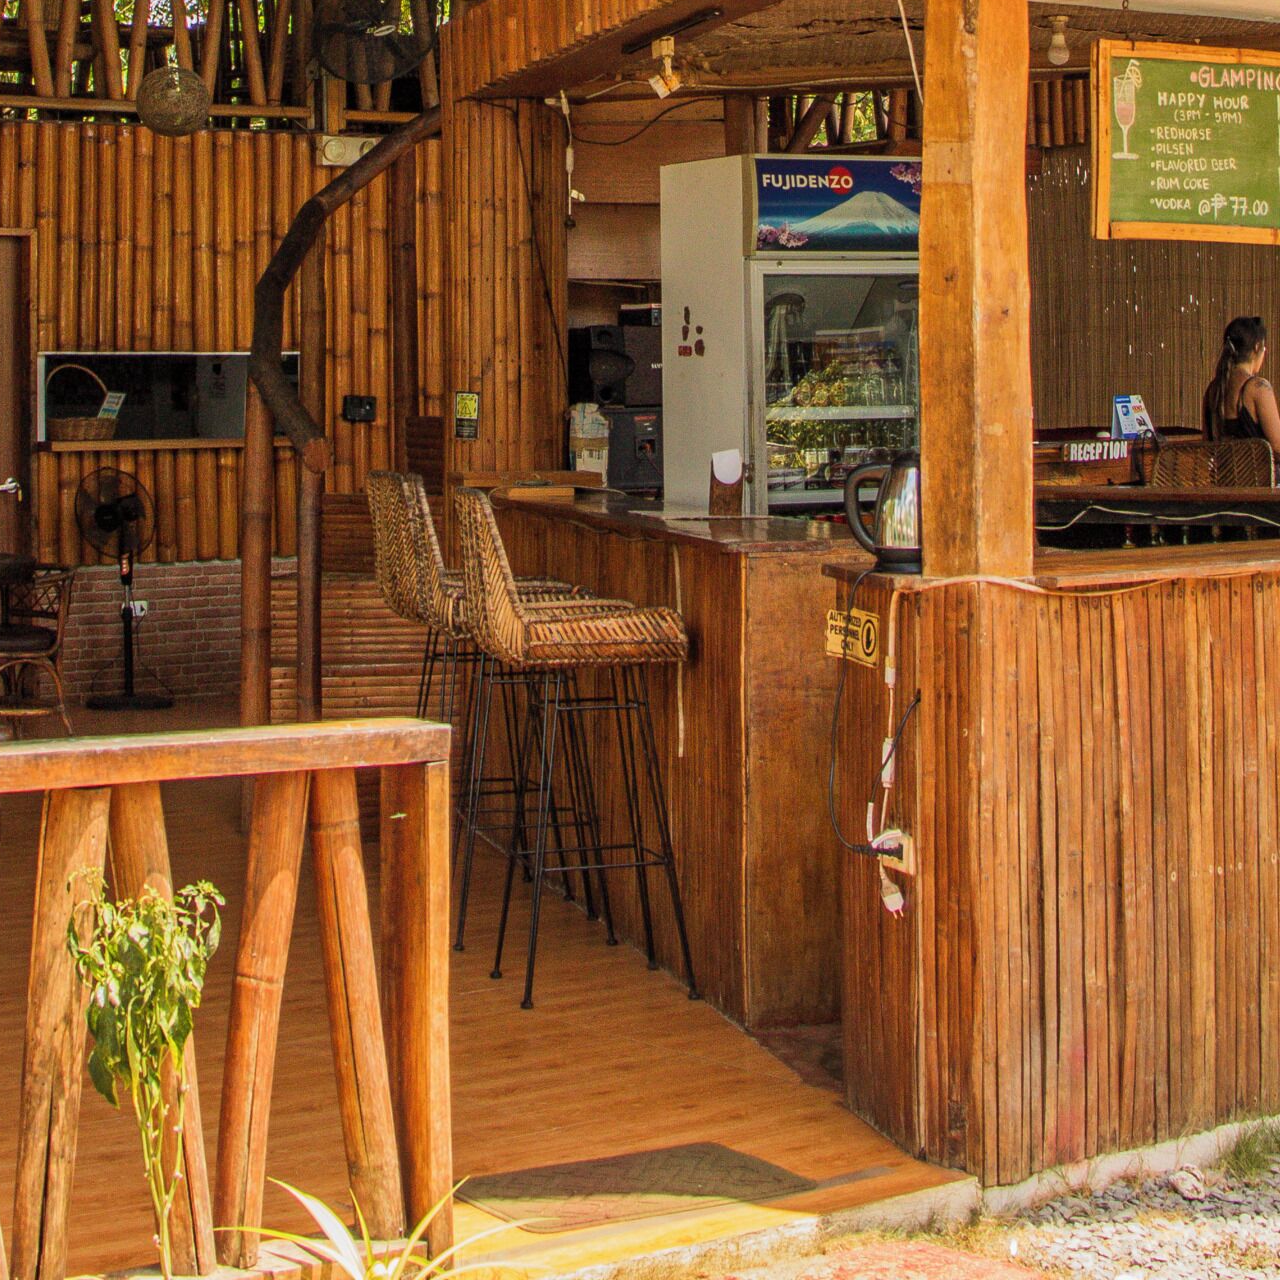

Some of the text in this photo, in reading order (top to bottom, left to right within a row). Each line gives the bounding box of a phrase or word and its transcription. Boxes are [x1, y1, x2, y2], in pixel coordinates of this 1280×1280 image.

[1157, 91, 1250, 110] HAPPY HOUR
[1156, 126, 1212, 140] REDHORSE
[1155, 143, 1194, 155] PILSEN
[1155, 158, 1238, 172] FLAVORED BEER
[761, 173, 854, 191] FUJIDENZO
[1157, 176, 1210, 190] RUM COKE
[1155, 198, 1192, 210] VODKA
[1070, 440, 1128, 462] RECEPTION
[829, 611, 862, 628] AUTHRIZED
[829, 624, 860, 641] PERSNNEL
